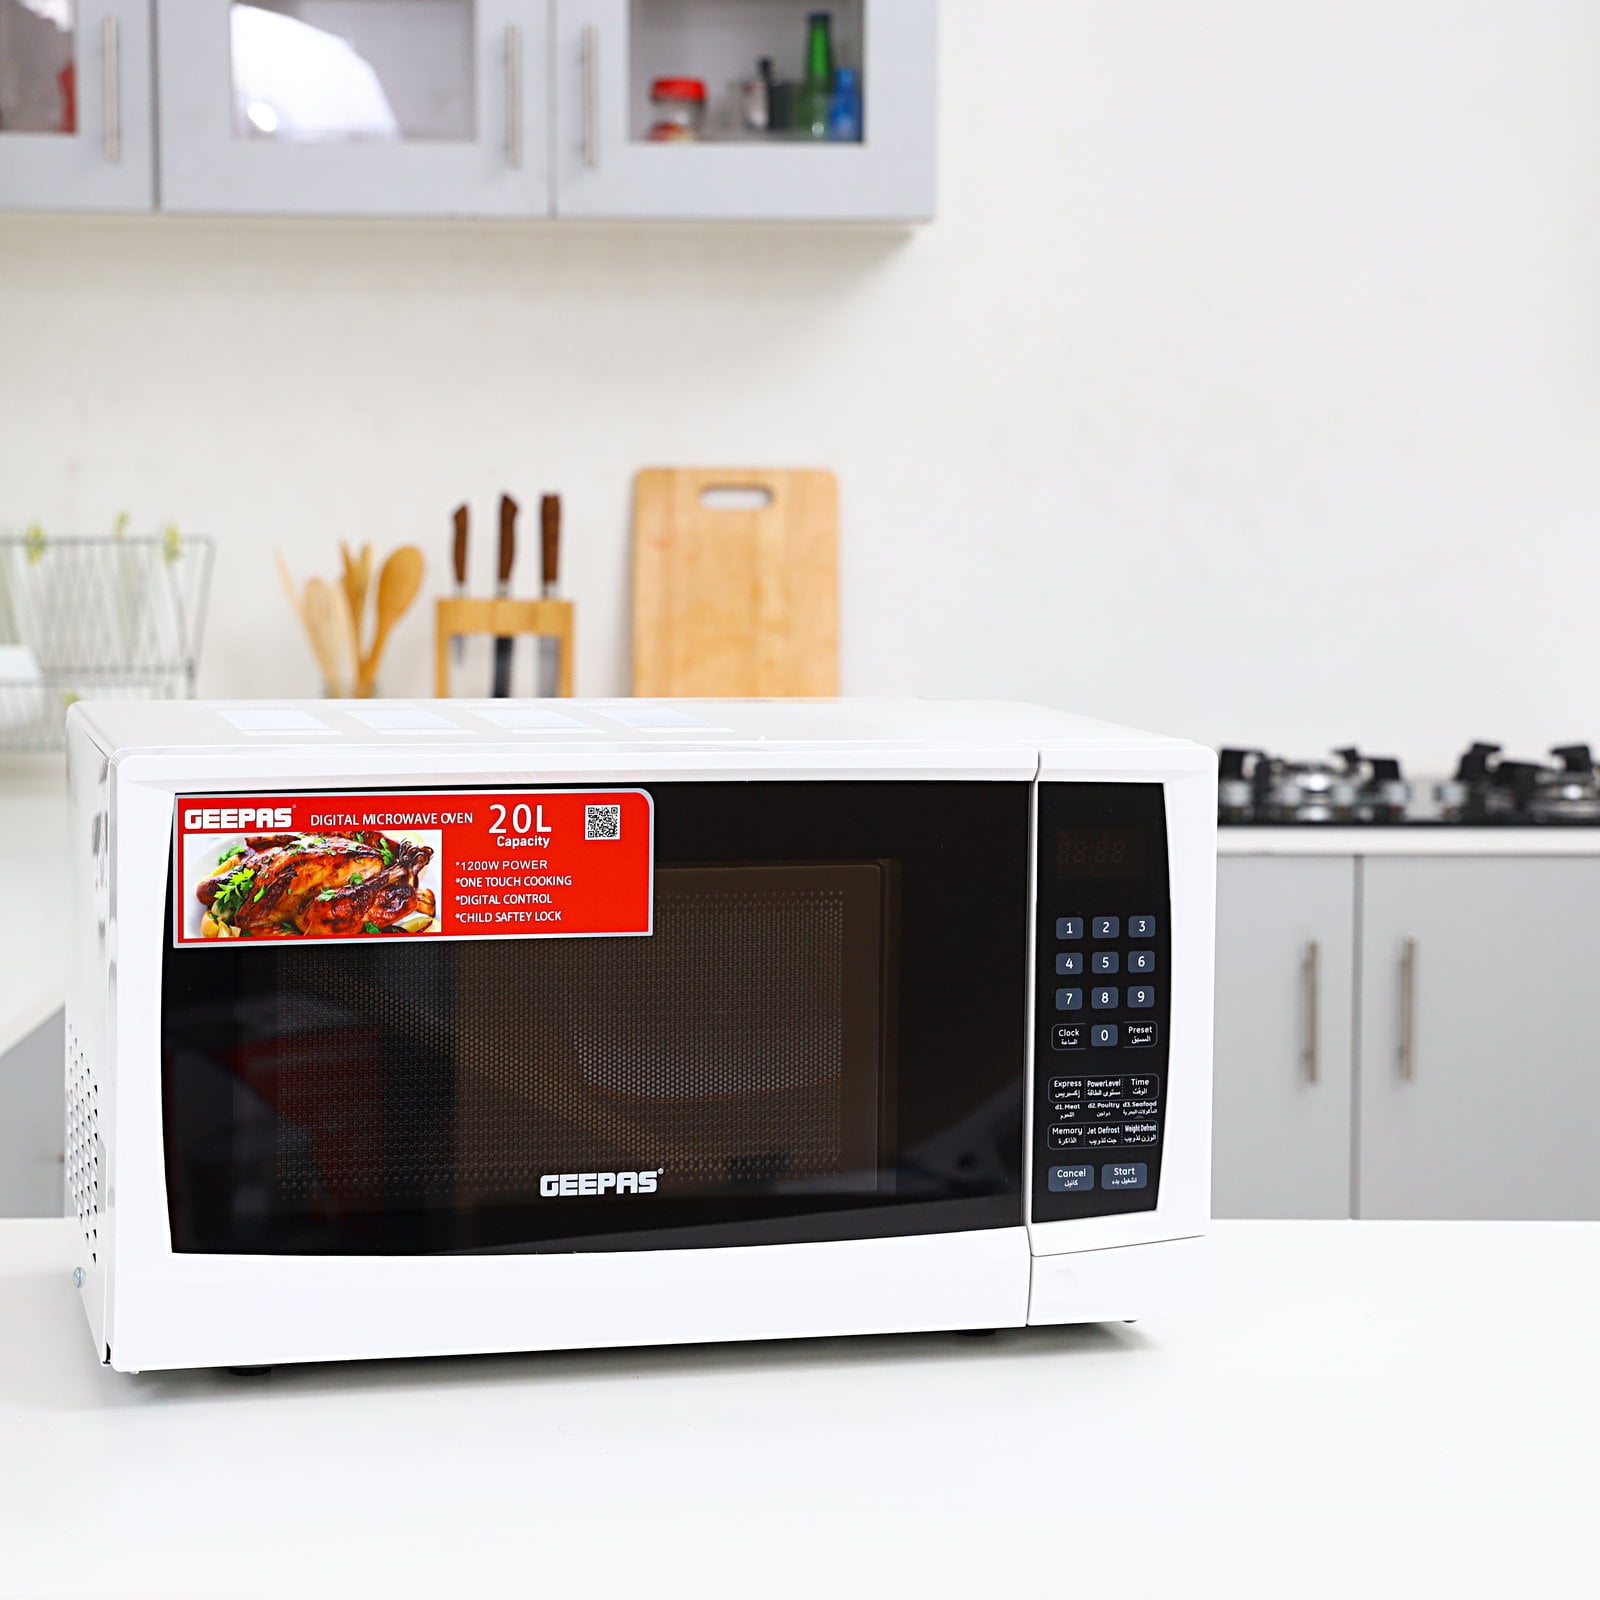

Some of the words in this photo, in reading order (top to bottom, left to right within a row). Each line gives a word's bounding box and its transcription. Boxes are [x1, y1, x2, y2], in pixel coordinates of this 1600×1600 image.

[184, 808, 292, 830] GEEPAS
[310, 813, 359, 826] DIGITAL
[361, 812, 438, 825] MICROWAVE
[440, 812, 474, 824] OVEN
[488, 803, 552, 834] 20L
[496, 835, 551, 849] Capacity
[502, 859, 548, 870] POWER
[485, 876, 521, 887] TOUCH
[523, 875, 572, 886] COOKING
[505, 893, 553, 905] CONTROL
[495, 911, 533, 922] SAFTEY
[534, 910, 562, 922] LOCK
[1066, 922, 1073, 934] 1
[1102, 922, 1110, 933] 2
[1139, 921, 1146, 932] 3
[1065, 958, 1073, 969] 4
[1102, 957, 1109, 968] 5
[1138, 956, 1145, 967] 6
[1066, 993, 1073, 1004] 7
[1101, 992, 1109, 1003] 8
[1138, 991, 1145, 1002] 9
[1059, 1029, 1080, 1037] Clock
[1101, 1030, 1108, 1041] 0
[1128, 1026, 1152, 1034] Preset
[1054, 1080, 1082, 1088] Express
[1087, 1079, 1121, 1087] PowerLevel
[1052, 1127, 1082, 1135] Memory
[1125, 1125, 1140, 1133] Weight
[1057, 1168, 1086, 1178] Cancel
[1114, 1167, 1135, 1176] Start
[540, 1171, 658, 1197] GEEPAS
